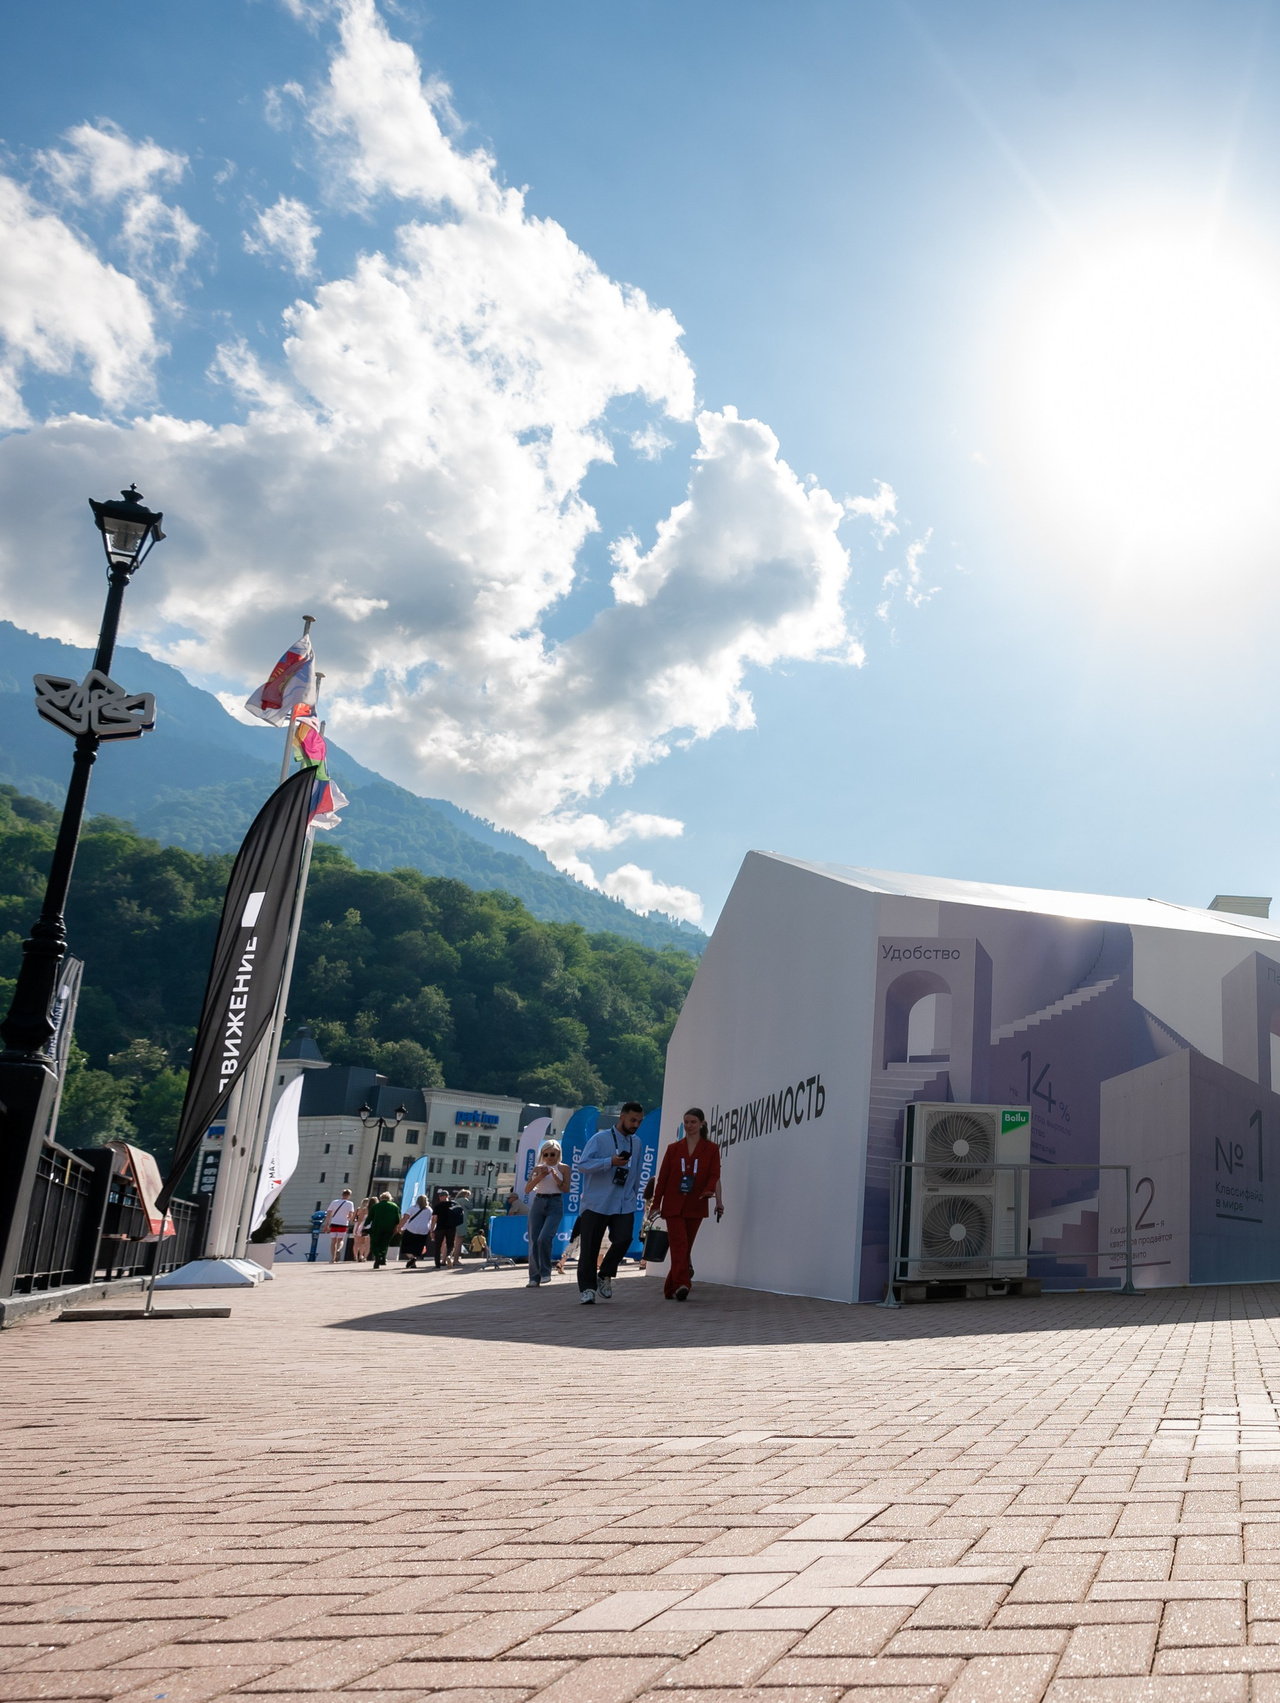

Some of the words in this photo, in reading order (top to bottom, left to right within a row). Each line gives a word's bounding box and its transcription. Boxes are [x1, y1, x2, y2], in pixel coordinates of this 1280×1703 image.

[882, 944, 961, 961] Удобство
[710, 1074, 826, 1160] Недвижимость
[1005, 1113, 1026, 1122] Ballu
[1215, 1181, 1263, 1203] Классифайд
[1215, 1199, 1221, 1207] в
[1223, 1200, 1244, 1212] мире
[1110, 1238, 1138, 1248] квартра
